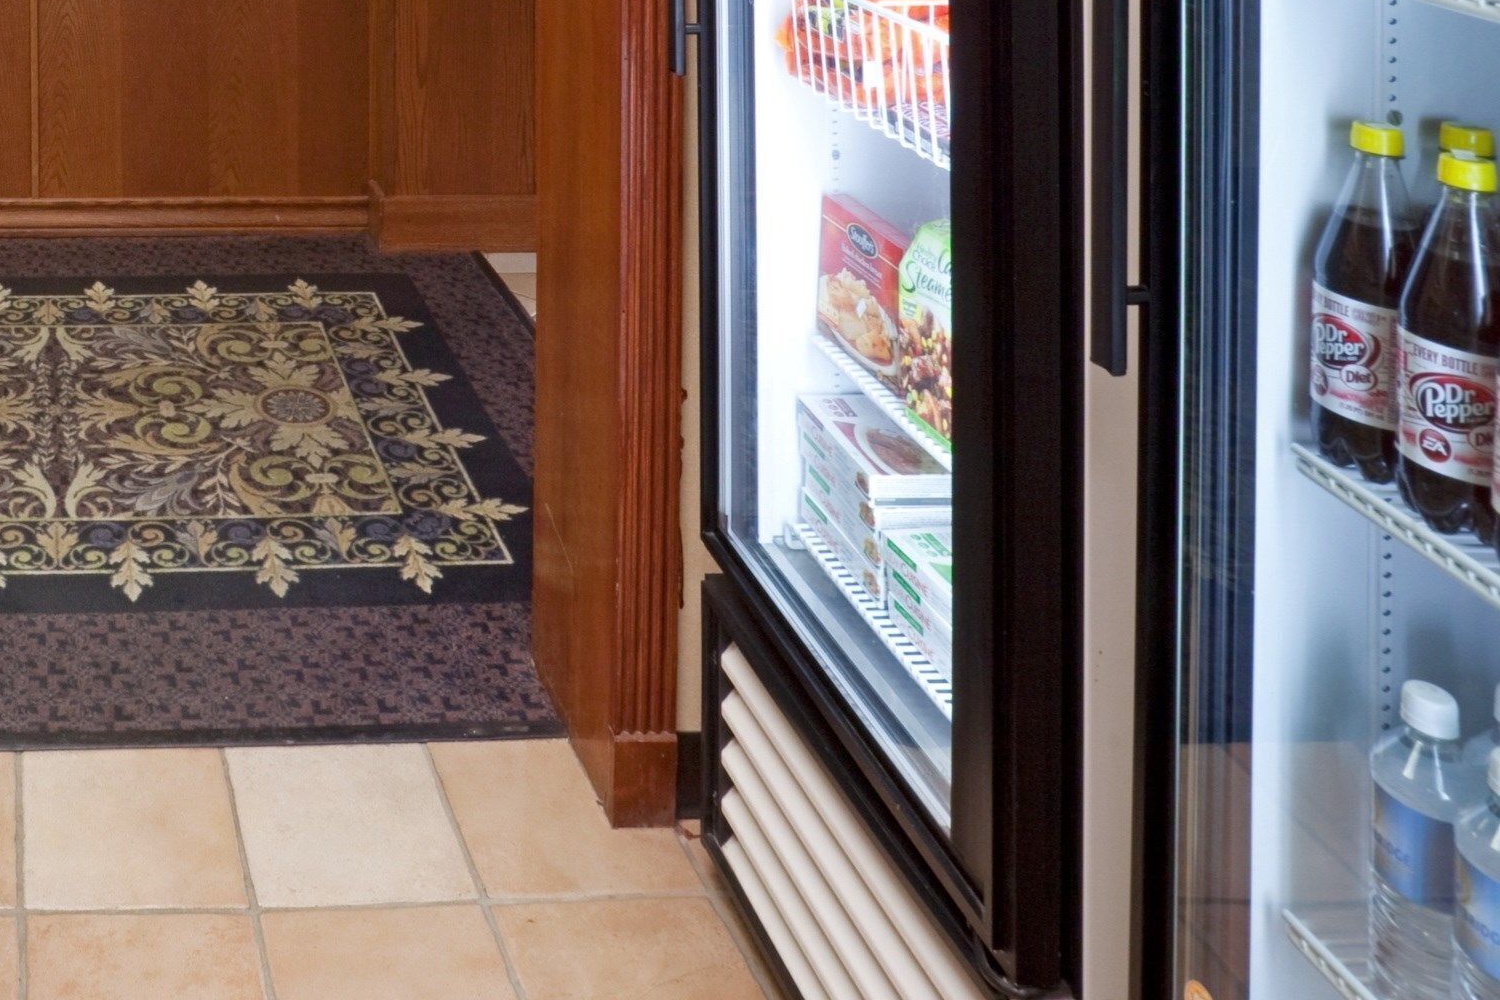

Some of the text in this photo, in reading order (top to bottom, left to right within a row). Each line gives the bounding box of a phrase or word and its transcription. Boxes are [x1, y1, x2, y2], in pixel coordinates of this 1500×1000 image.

[1325, 324, 1348, 343] Dr
[1412, 343, 1478, 376] EVERY BOTTLE
[1345, 370, 1371, 384] Diet
[1423, 382, 1494, 425] Pepper
[1444, 382, 1476, 404] Dr
